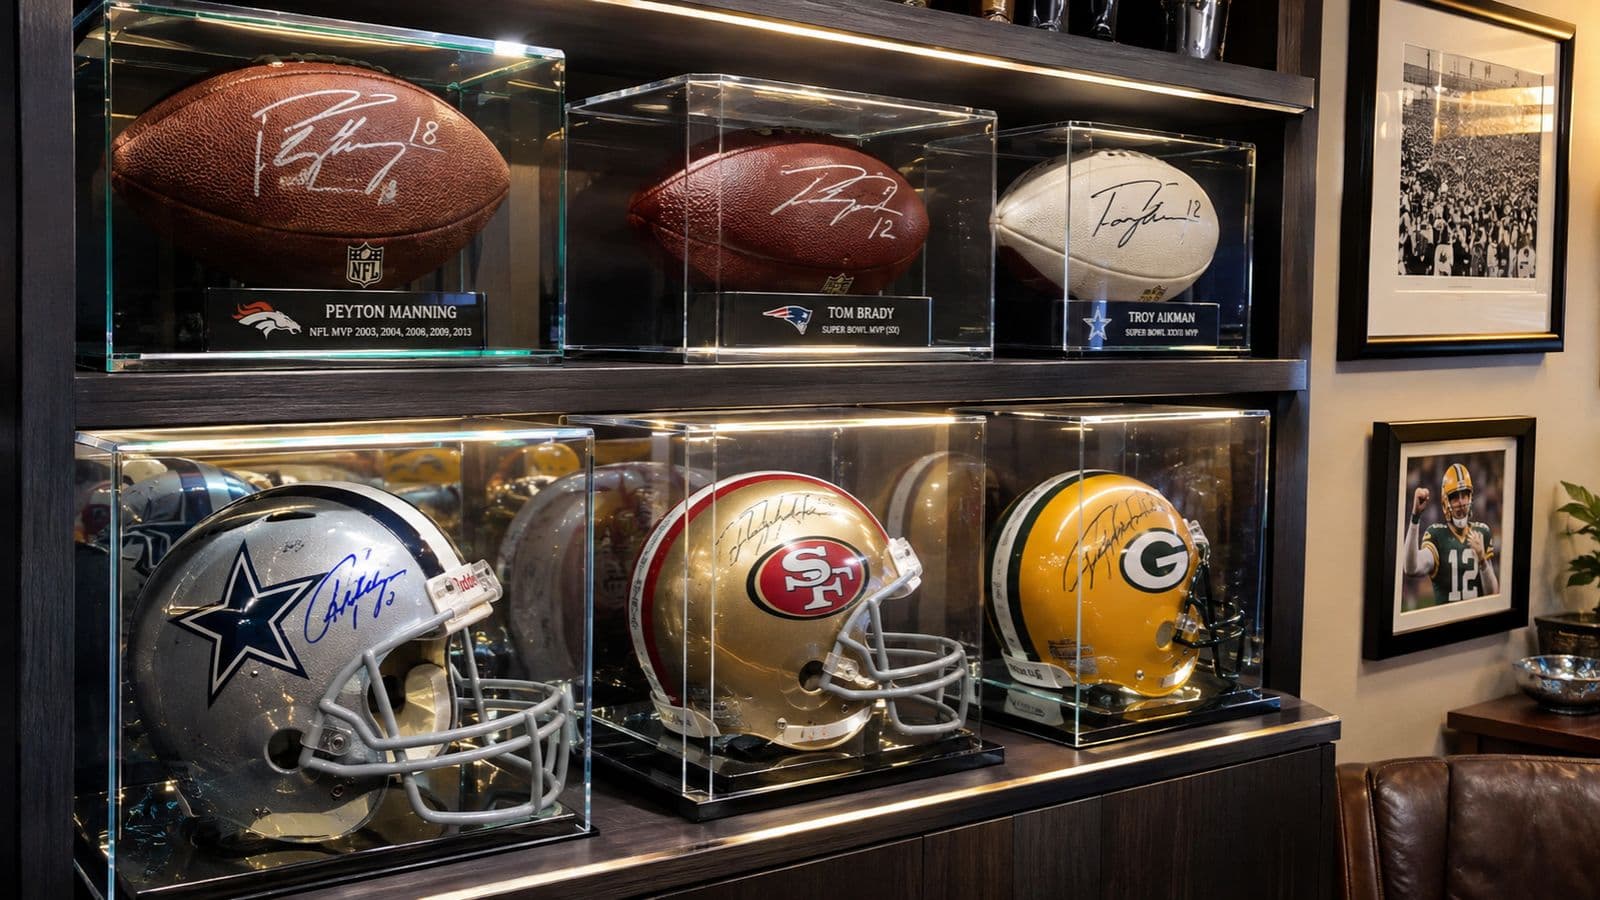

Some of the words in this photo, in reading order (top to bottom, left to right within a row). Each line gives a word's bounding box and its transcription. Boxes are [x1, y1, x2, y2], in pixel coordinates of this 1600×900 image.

[409, 116, 439, 145] 18
[1187, 199, 1201, 218] 12
[868, 217, 896, 239] 12
[351, 261, 379, 281] NFL
[325, 303, 385, 319] PEYTON
[389, 304, 457, 319] MANNING
[828, 306, 854, 319] TOM
[857, 307, 895, 320] BRADY
[1128, 311, 1155, 323] TROY
[1157, 312, 1196, 323] AIKMAN
[309, 327, 329, 337] NFL
[331, 327, 353, 337] MVP
[355, 327, 379, 338] 2003,
[380, 327, 404, 338] 2004,
[430, 327, 452, 338] 2009,
[453, 327, 472, 337] 2013
[822, 325, 846, 334] SUPER
[847, 325, 868, 334] BOWL
[869, 326, 885, 334] MVP
[1125, 328, 1146, 337] SUPER
[1147, 328, 1167, 337] BOWL
[1123, 530, 1189, 589] G
[782, 546, 855, 611] SF
[1448, 548, 1480, 601] 12
